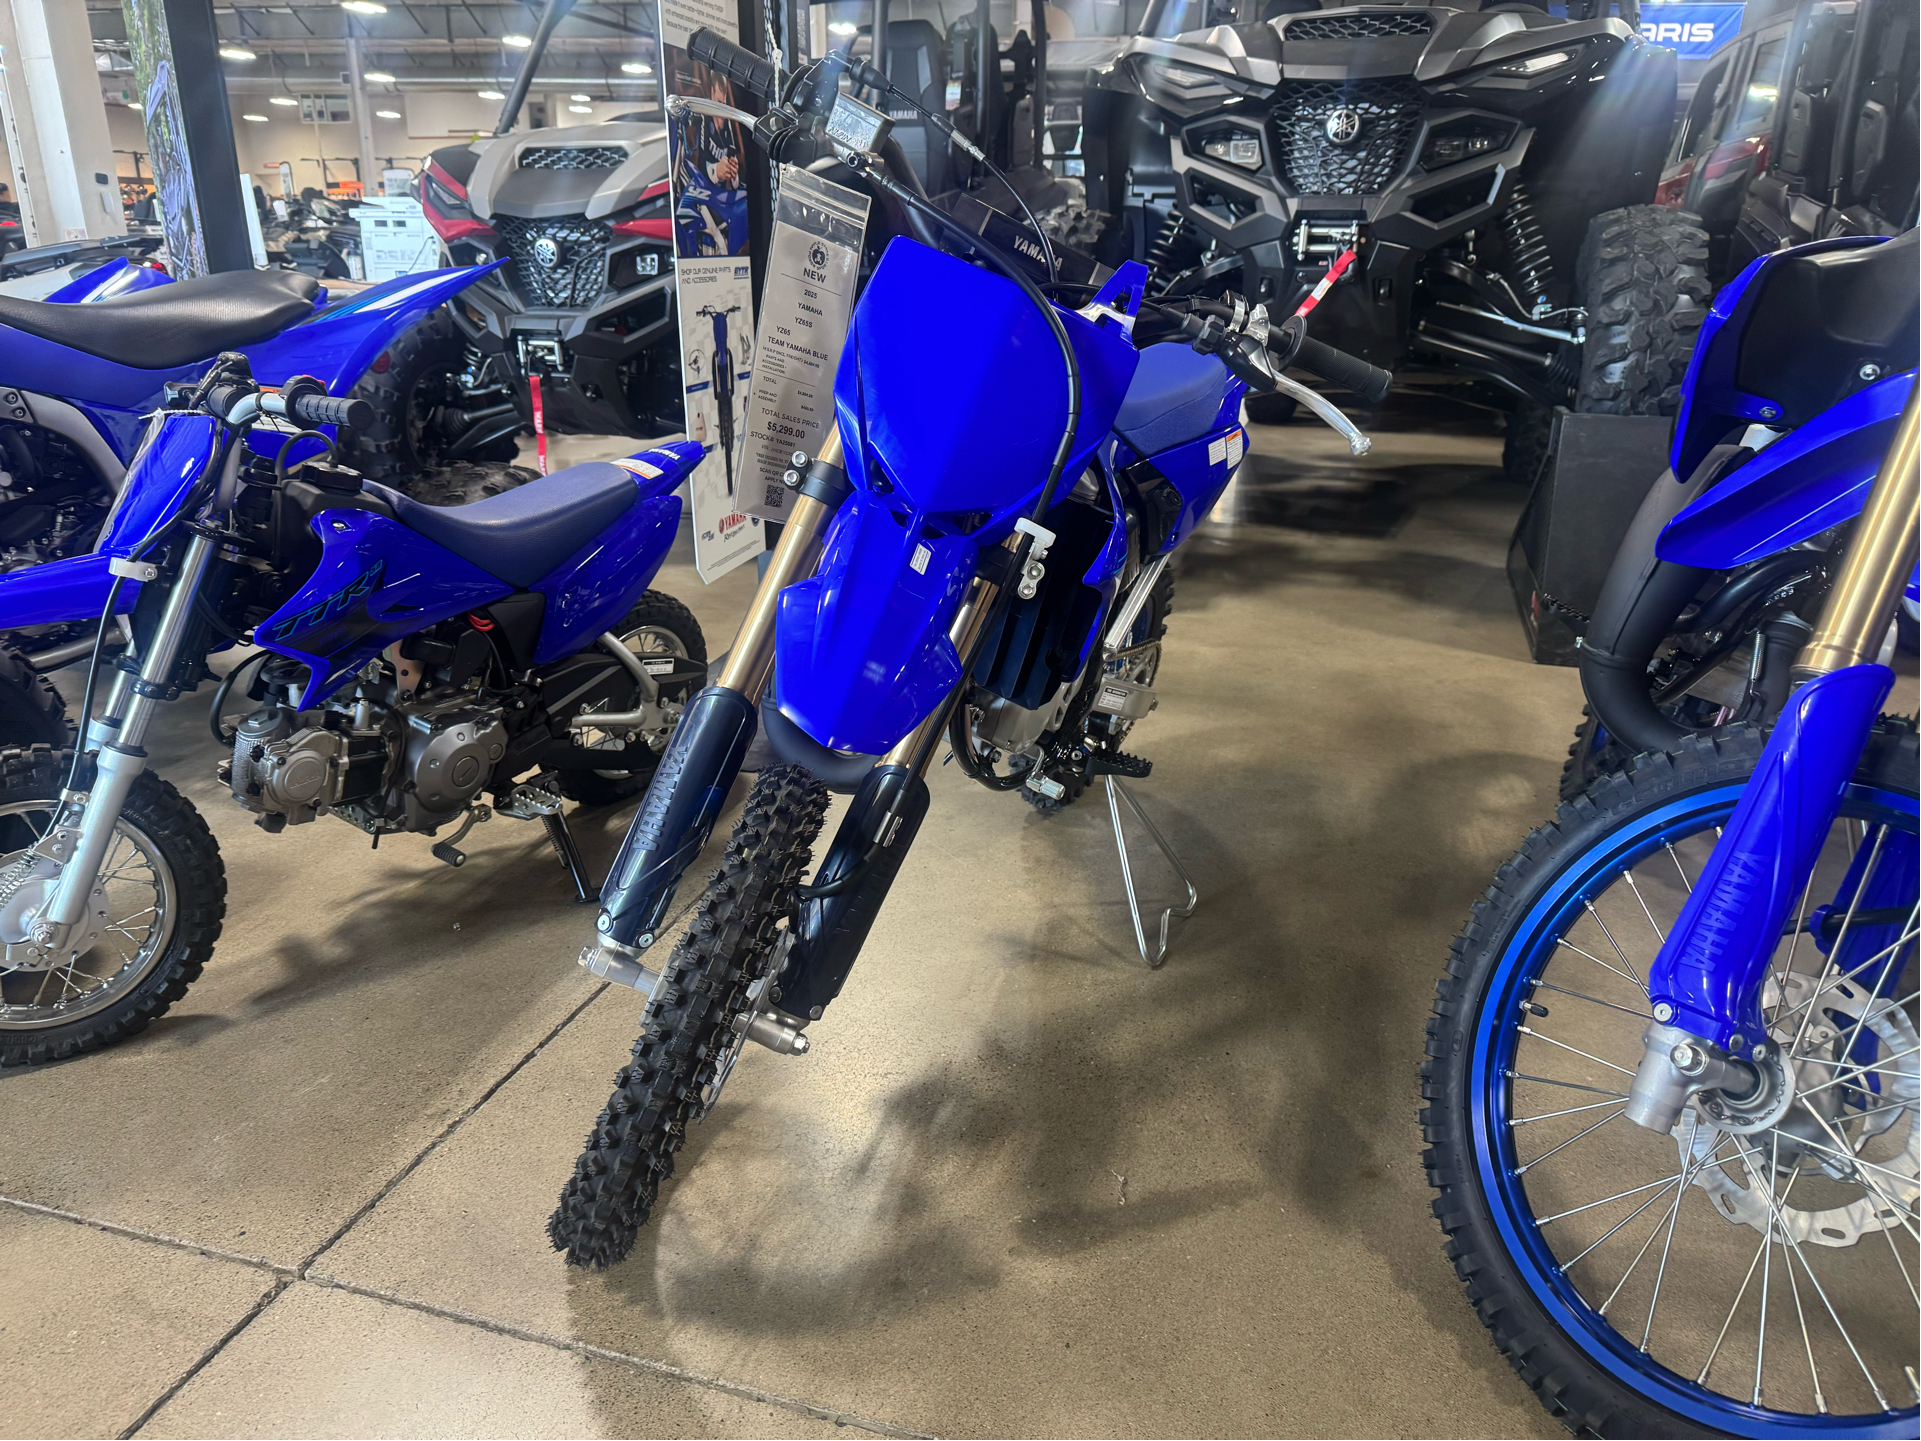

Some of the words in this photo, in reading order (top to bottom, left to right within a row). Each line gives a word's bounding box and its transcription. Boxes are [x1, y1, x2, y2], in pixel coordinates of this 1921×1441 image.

[888, 110, 918, 120] YAMAHA
[1013, 235, 1063, 272] YAMAA
[803, 267, 827, 284] NEW
[804, 289, 818, 299] 2025
[798, 301, 823, 317] YAMAHA
[776, 325, 791, 336] YZ65
[794, 316, 813, 328] YZ65S
[768, 336, 785, 347] TEAM
[786, 341, 811, 356] YAMAHA
[812, 350, 829, 361] BLUE
[763, 375, 777, 385] TOTAL
[762, 407, 780, 419] TOTAL
[782, 413, 801, 424] SALES
[801, 419, 820, 429] PRICE
[750, 430, 775, 442] STOCK#
[767, 421, 806, 439] $5,299.00
[272, 571, 370, 641] TTR
[632, 745, 688, 851] YAMAHA
[1679, 850, 1774, 973] YAMAHA
